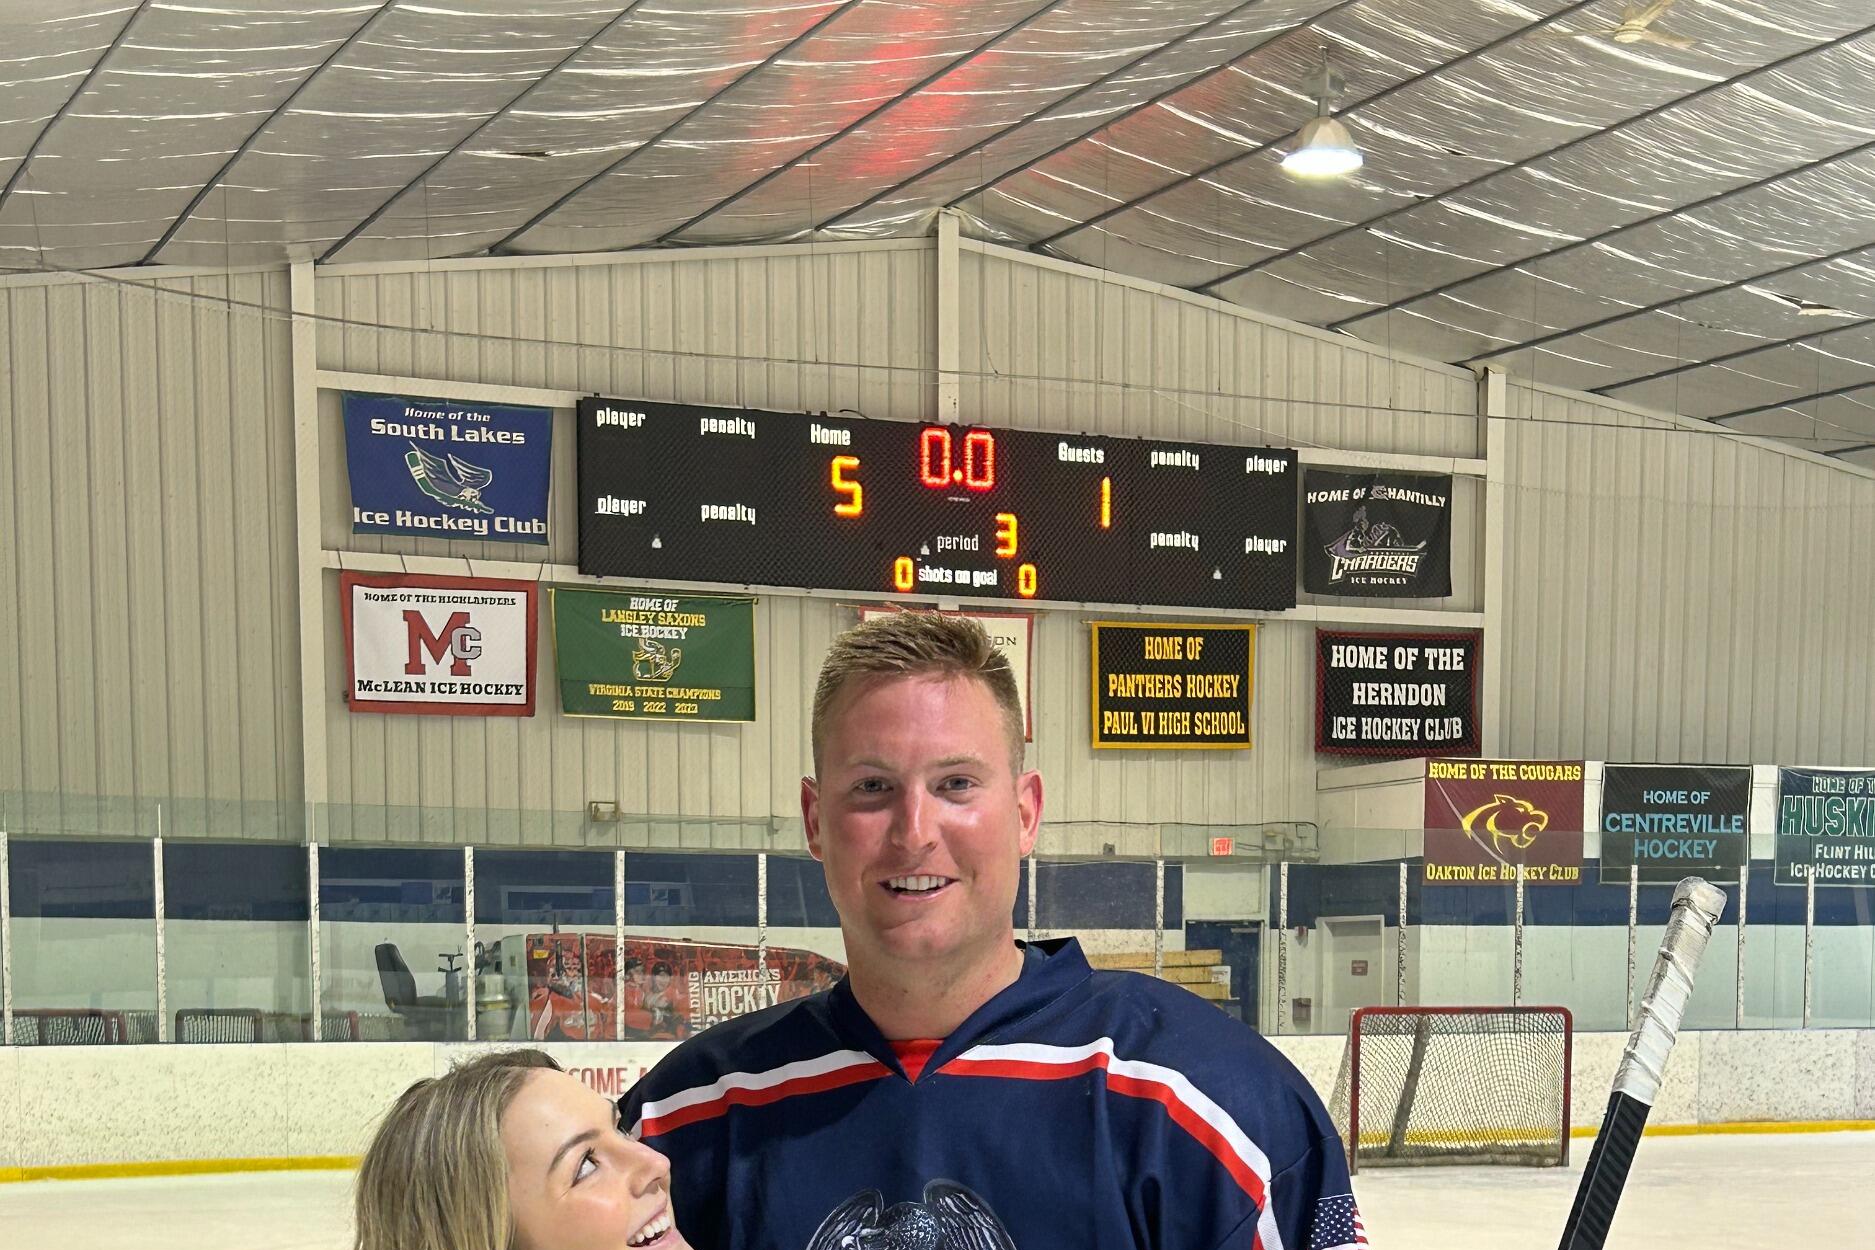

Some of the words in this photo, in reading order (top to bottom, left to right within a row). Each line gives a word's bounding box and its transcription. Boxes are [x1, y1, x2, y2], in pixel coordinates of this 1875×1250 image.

[404, 407, 445, 419] Home
[448, 411, 464, 420] of
[466, 412, 491, 422] the
[596, 407, 646, 429] player
[370, 418, 445, 441] South
[451, 425, 526, 445] Lakes
[700, 417, 756, 439] penalty
[810, 423, 851, 446] Home
[920, 427, 995, 490] 0.0
[1058, 442, 1105, 463] Guests
[1150, 450, 1199, 470] penalty
[1246, 455, 1288, 475] player
[831, 455, 864, 516] 5
[1307, 489, 1350, 504] HOME
[1352, 487, 1367, 500] OF
[596, 495, 647, 516] player
[1101, 476, 1111, 528] 1
[353, 507, 390, 525] Ice
[395, 510, 489, 536] Hockey
[494, 516, 547, 535] Club
[701, 503, 756, 525] penalty
[937, 534, 979, 552] period
[995, 512, 1018, 558] 3
[1150, 531, 1199, 551] penalty
[1245, 535, 1287, 555] player
[894, 556, 914, 591] 0
[918, 565, 953, 584] shots
[955, 568, 971, 584] on
[972, 569, 998, 588] goal
[1018, 563, 1037, 597] 0
[364, 592, 398, 602] HOME
[415, 594, 437, 603] THE
[629, 597, 662, 611] HOME
[663, 599, 679, 612] OF
[601, 609, 656, 624] LANGLEY
[620, 624, 640, 638] ICE
[640, 625, 688, 640] HOCKEY
[1144, 636, 1183, 660] HOME
[1187, 637, 1204, 660] OF
[1331, 645, 1388, 670] HOME
[1394, 646, 1419, 670] OF
[1424, 648, 1465, 671] THE
[430, 682, 457, 695] ICE
[460, 683, 524, 696] HOCKEY
[1108, 674, 1182, 698] PANTHERS
[1186, 675, 1240, 698] HOCKEY
[1352, 682, 1446, 706] HERNDON
[1103, 711, 1138, 735] PAUL
[1141, 711, 1155, 735] VI
[1159, 711, 1191, 735] HIGH
[1194, 711, 1245, 736] SCHOOL
[1331, 716, 1357, 740] ICE
[1361, 717, 1421, 741] HOCKEY
[1424, 716, 1463, 741] CLUB
[1429, 762, 1467, 779] HOME
[1470, 764, 1488, 780] OF
[1490, 764, 1518, 780] THE
[1519, 765, 1582, 781] COUGARS
[1848, 777, 1865, 794] OF
[1643, 790, 1688, 804] HOME
[1690, 791, 1711, 805] OF
[1605, 812, 1744, 833] CENTREVILLE
[1634, 838, 1718, 859] HOCKEY
[1815, 844, 1851, 859] FLINT
[1426, 863, 1475, 880] OAKTON
[1477, 863, 1497, 880] ICE
[1500, 863, 1547, 880] HOKEY
[1549, 863, 1579, 880] CLUB
[1815, 862, 1867, 879] HOCKEY
[704, 984, 781, 1015] HOCKY
